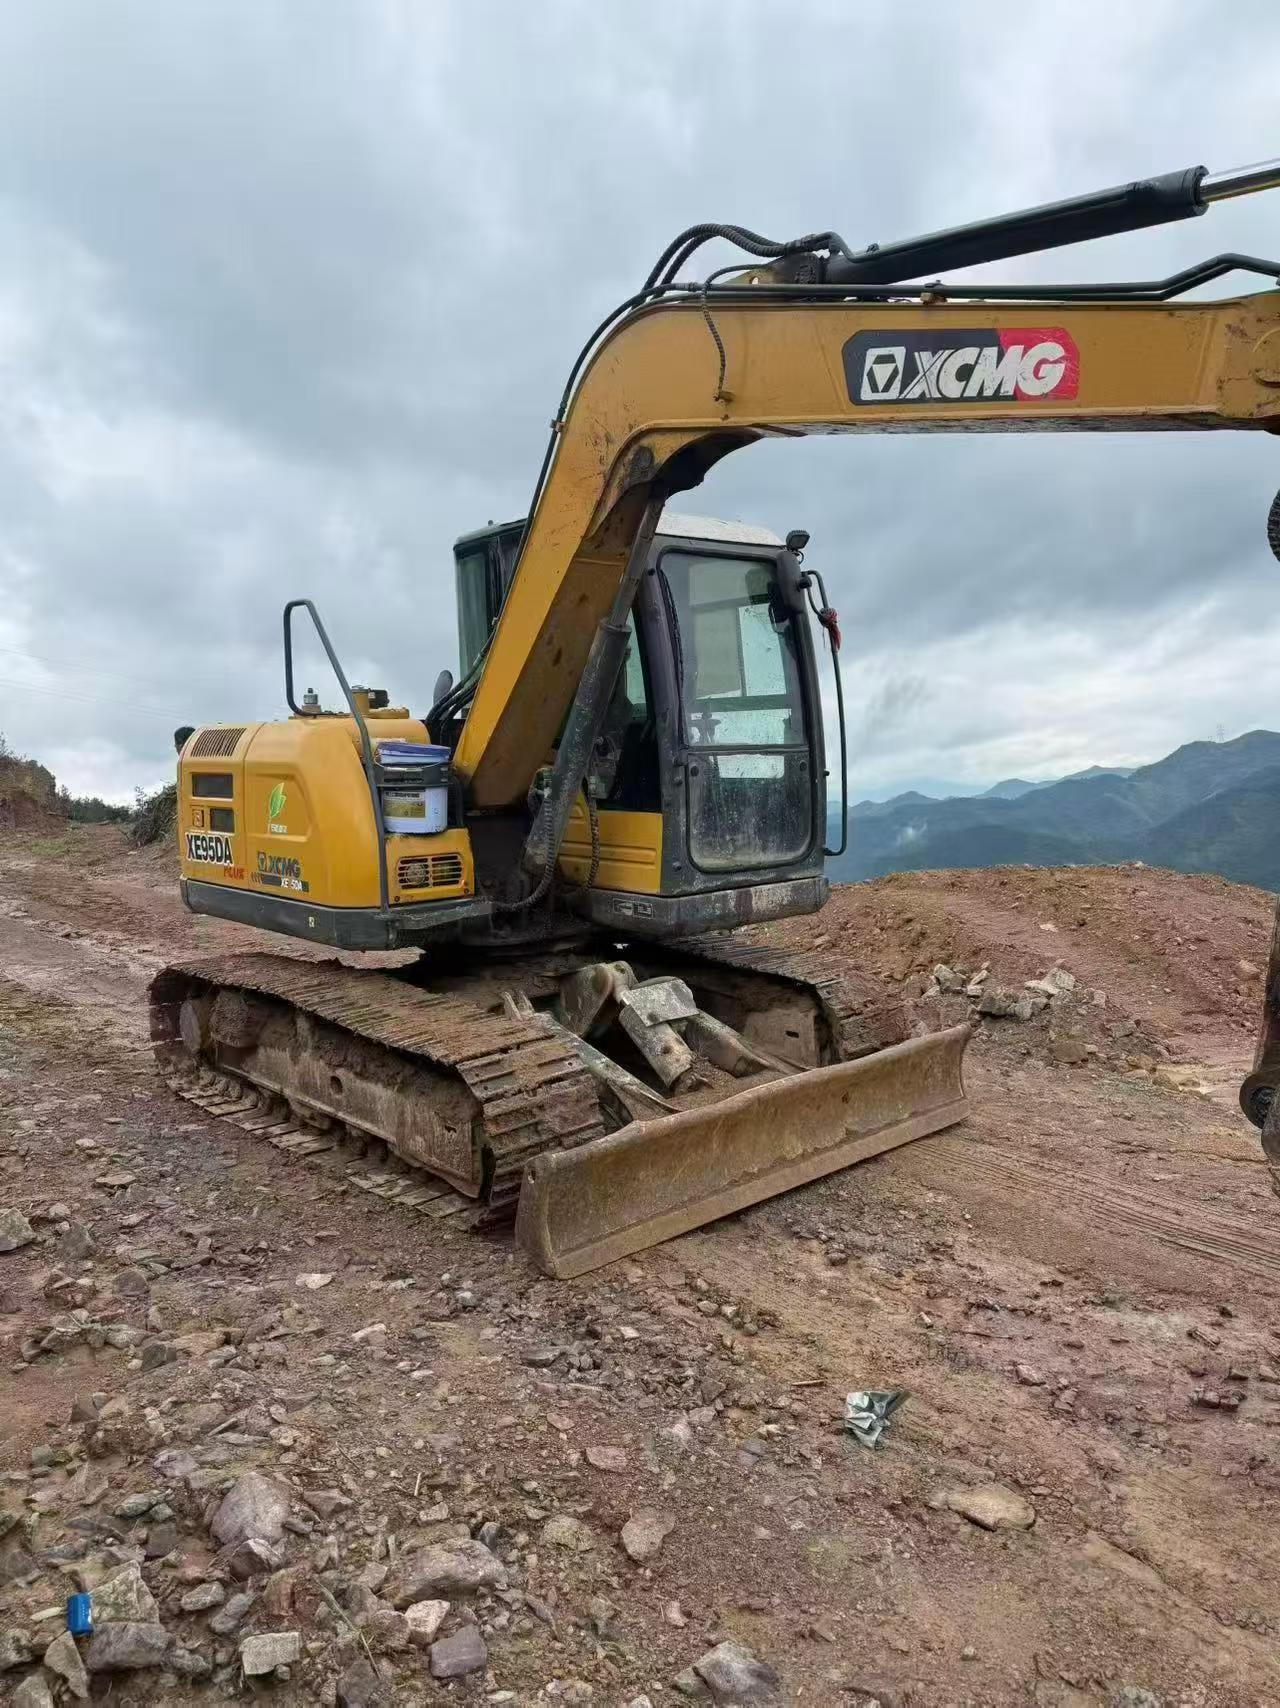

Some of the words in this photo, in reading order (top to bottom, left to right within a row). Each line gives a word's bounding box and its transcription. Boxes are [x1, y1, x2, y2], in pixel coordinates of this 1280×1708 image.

[899, 342, 1066, 398] XCMG
[186, 832, 234, 865] XE95DA
[268, 855, 301, 878] XCMG
